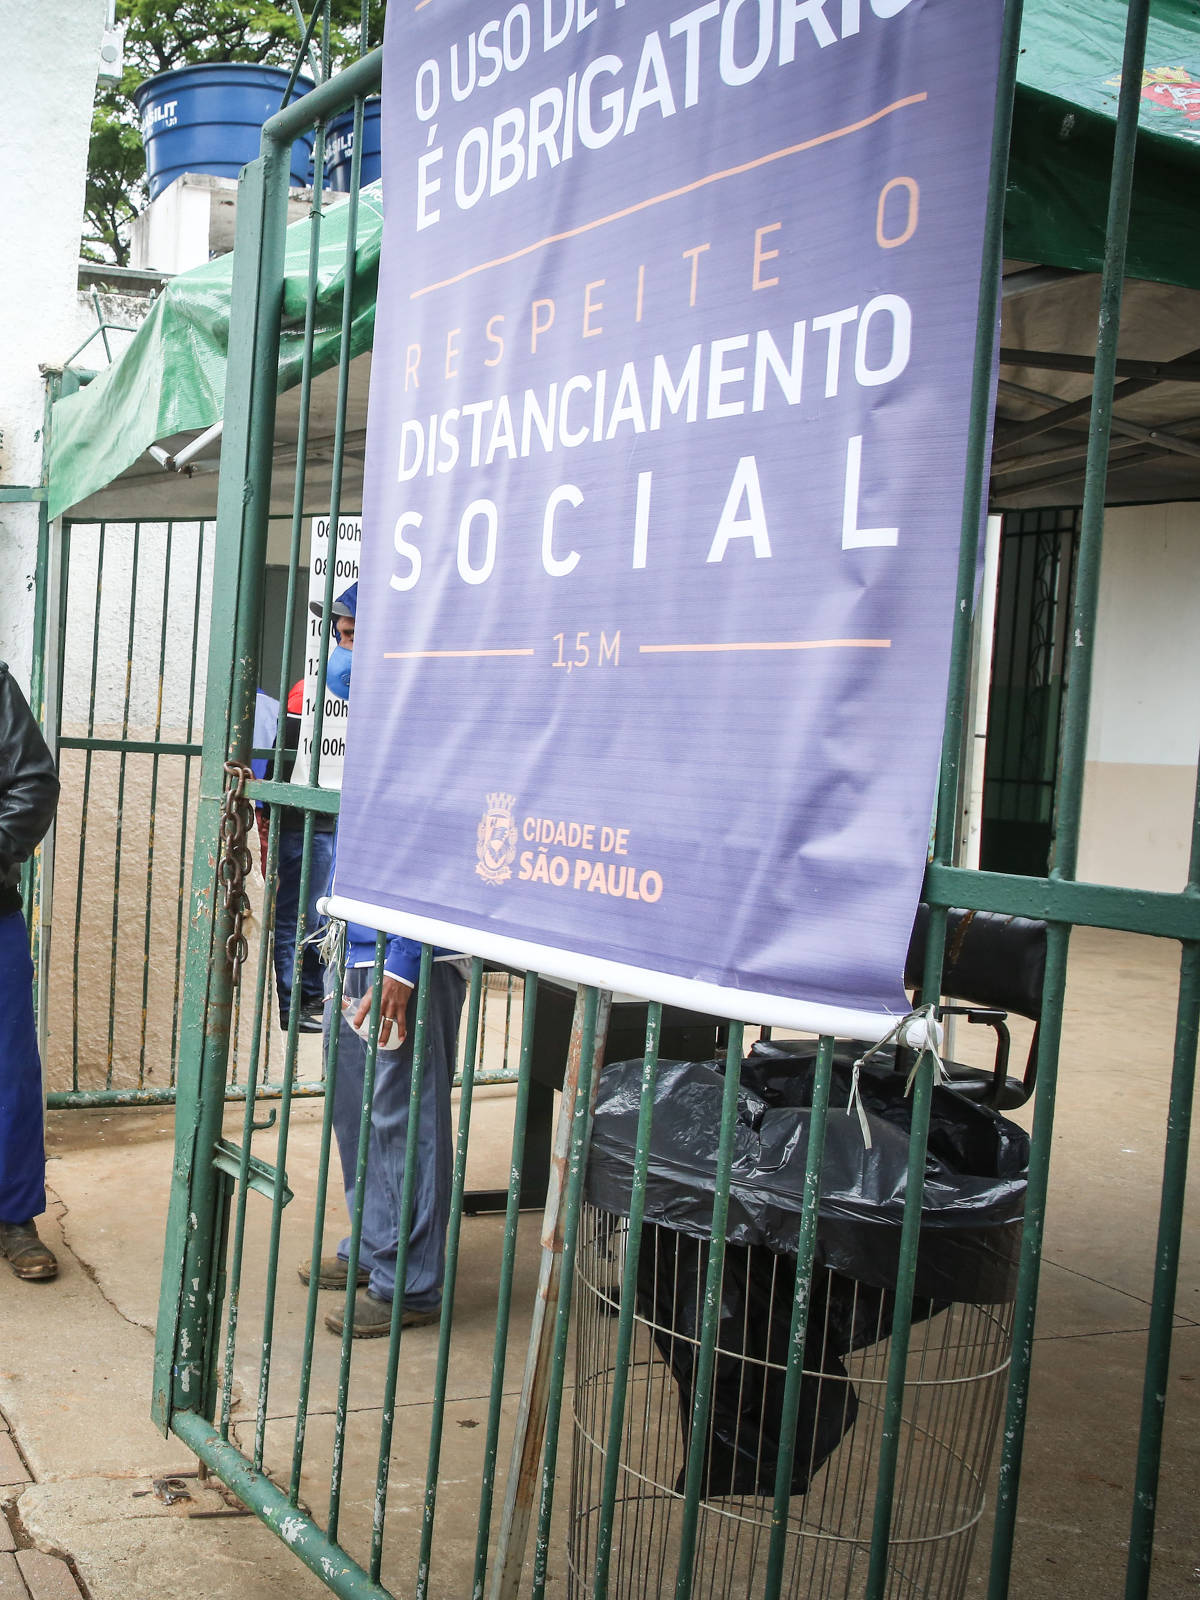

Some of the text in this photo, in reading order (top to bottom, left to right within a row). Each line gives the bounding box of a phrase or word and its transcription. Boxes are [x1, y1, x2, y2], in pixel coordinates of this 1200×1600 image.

[415, 59, 440, 121] O
[451, 3, 530, 102] USO
[416, 124, 444, 232] É
[405, 177, 920, 390] RESPEITE O
[398, 293, 912, 483] DISTANCIAMENTO
[389, 435, 899, 591] SOCIAL
[551, 630, 621, 674] 1,5 M
[518, 846, 663, 904] SÃO PAULO
[522, 816, 631, 855] CIDADE DE
